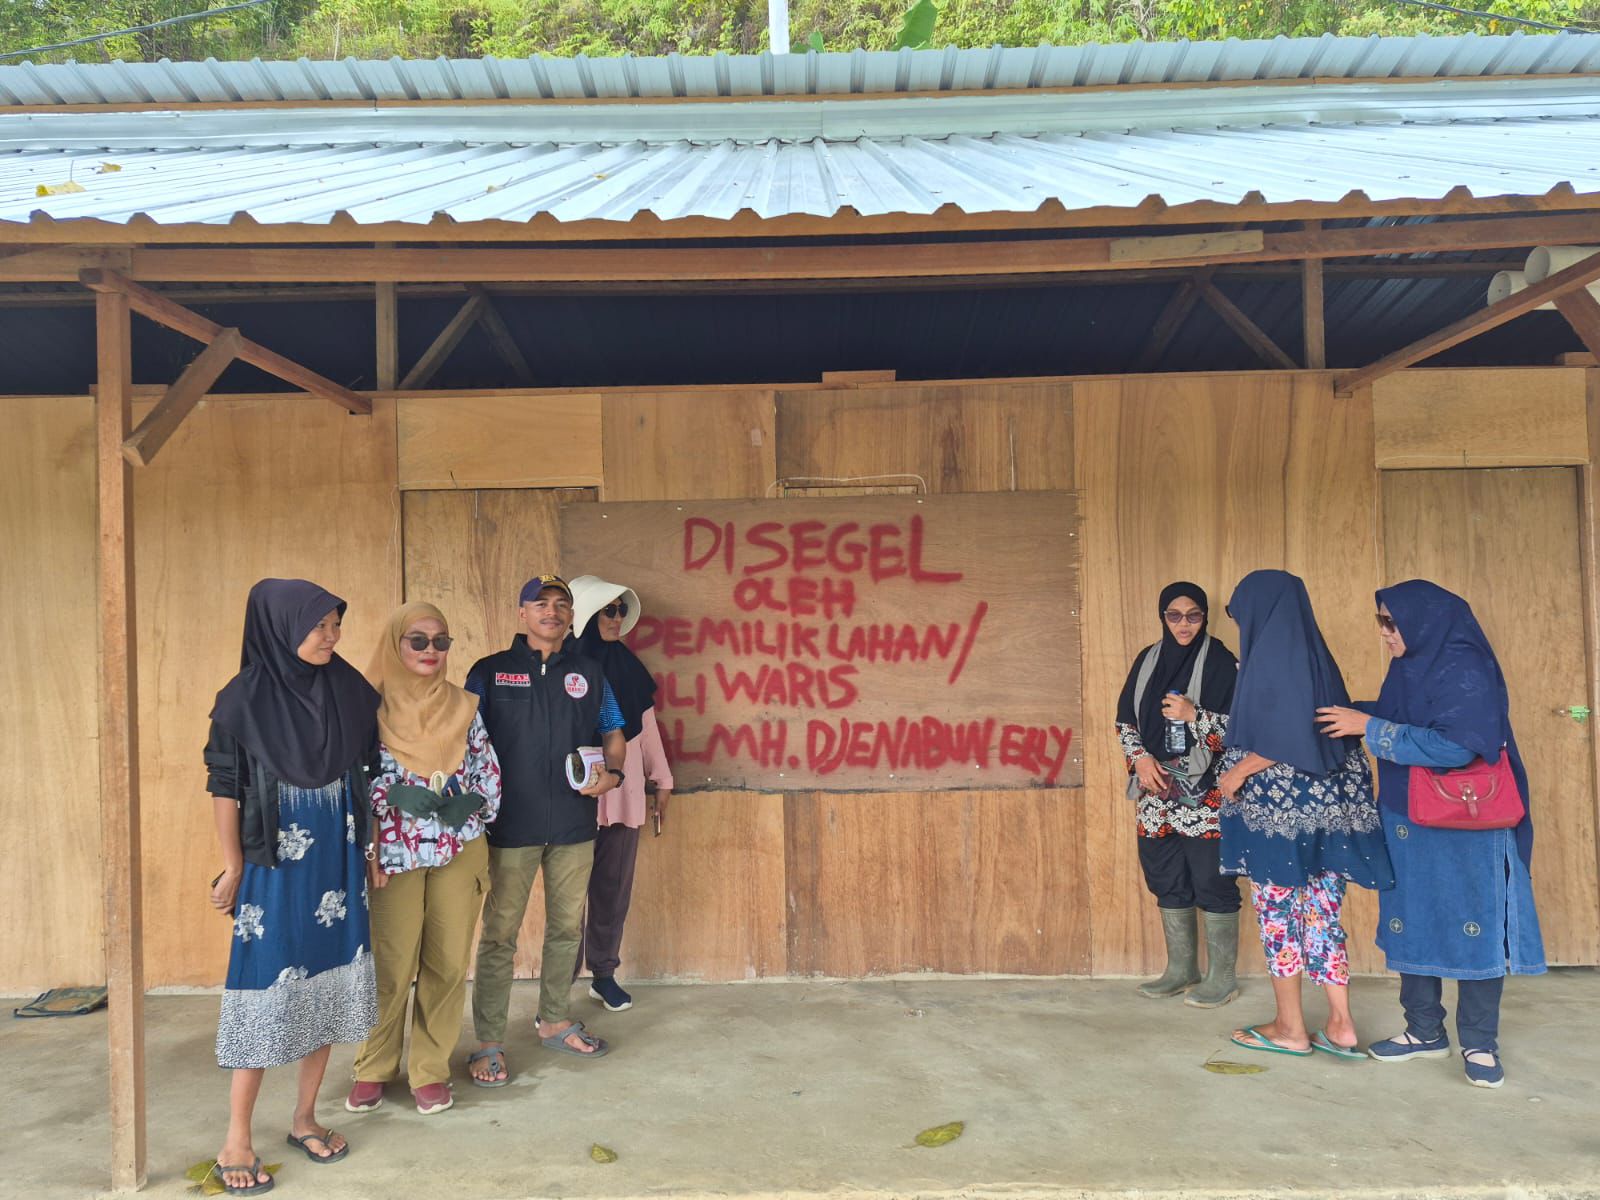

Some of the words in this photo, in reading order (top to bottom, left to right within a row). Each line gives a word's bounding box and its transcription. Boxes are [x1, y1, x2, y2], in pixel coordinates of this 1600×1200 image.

[683, 514, 963, 584] DISEGEL
[733, 577, 857, 620] OLEH
[713, 661, 860, 711] WARIS
